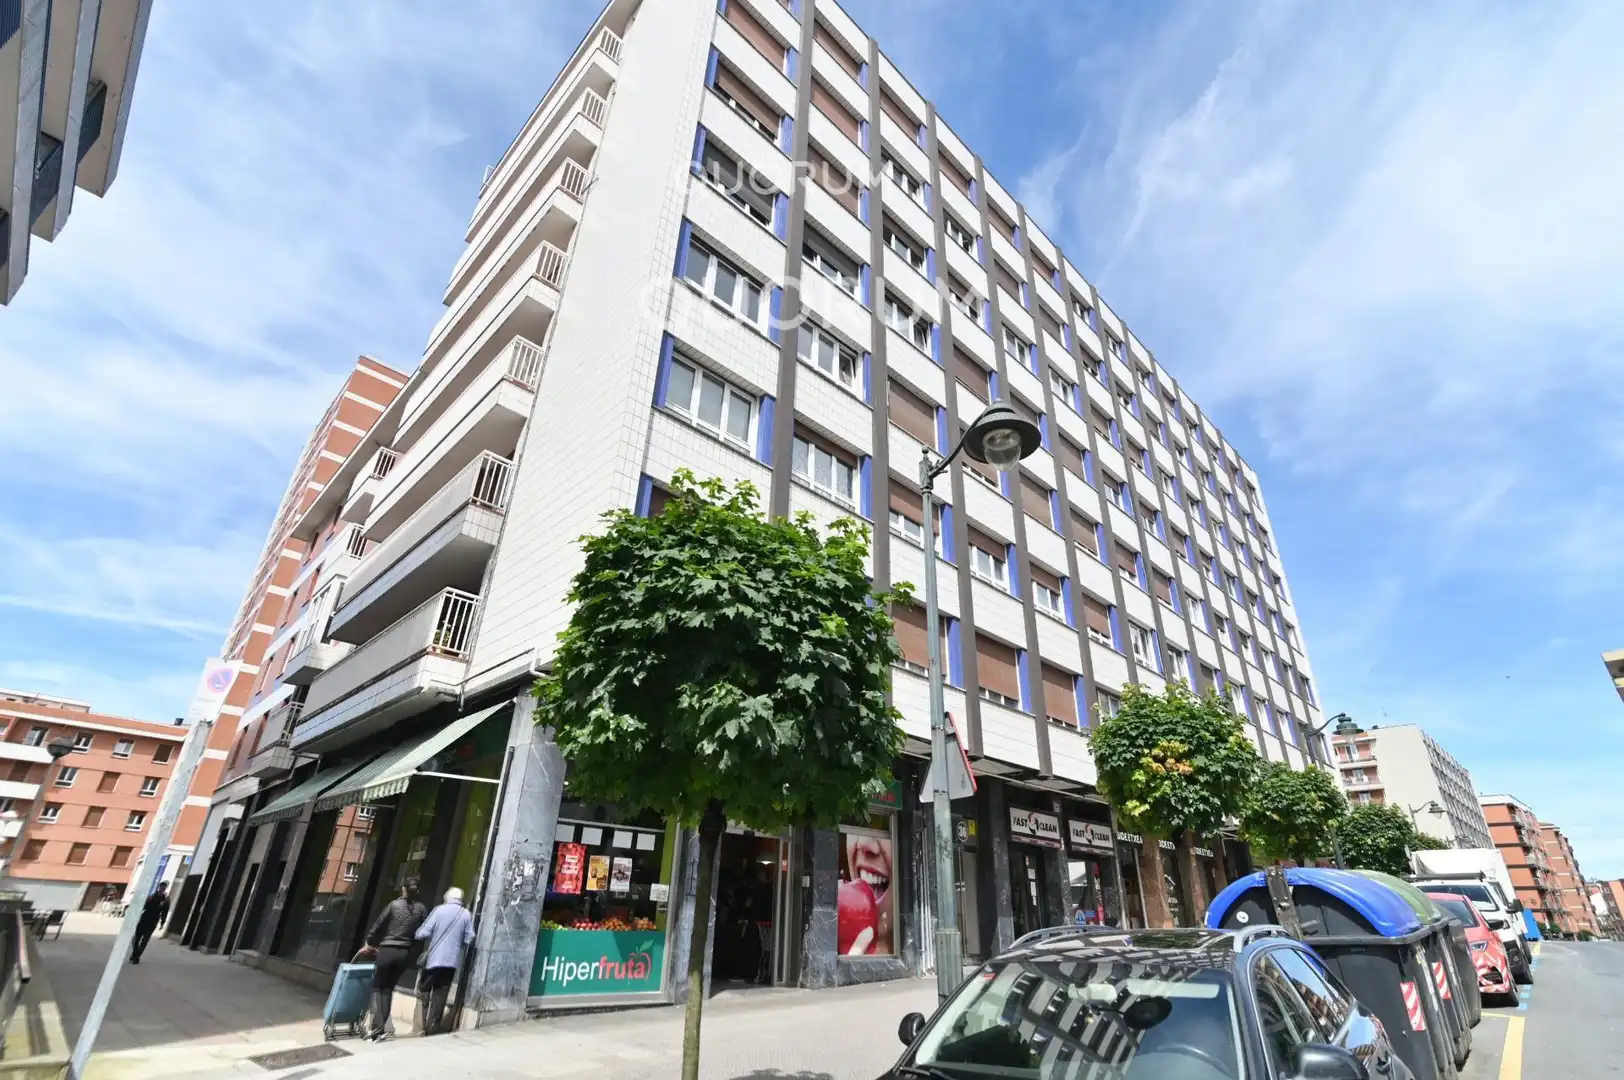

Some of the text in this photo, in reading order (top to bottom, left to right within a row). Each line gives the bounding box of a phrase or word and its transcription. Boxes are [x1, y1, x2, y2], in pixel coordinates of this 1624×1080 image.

[1013, 816, 1058, 834] FAST CLEAN
[1072, 827, 1110, 842] FAST CLEAN
[541, 955, 647, 987] Hiperfruta
